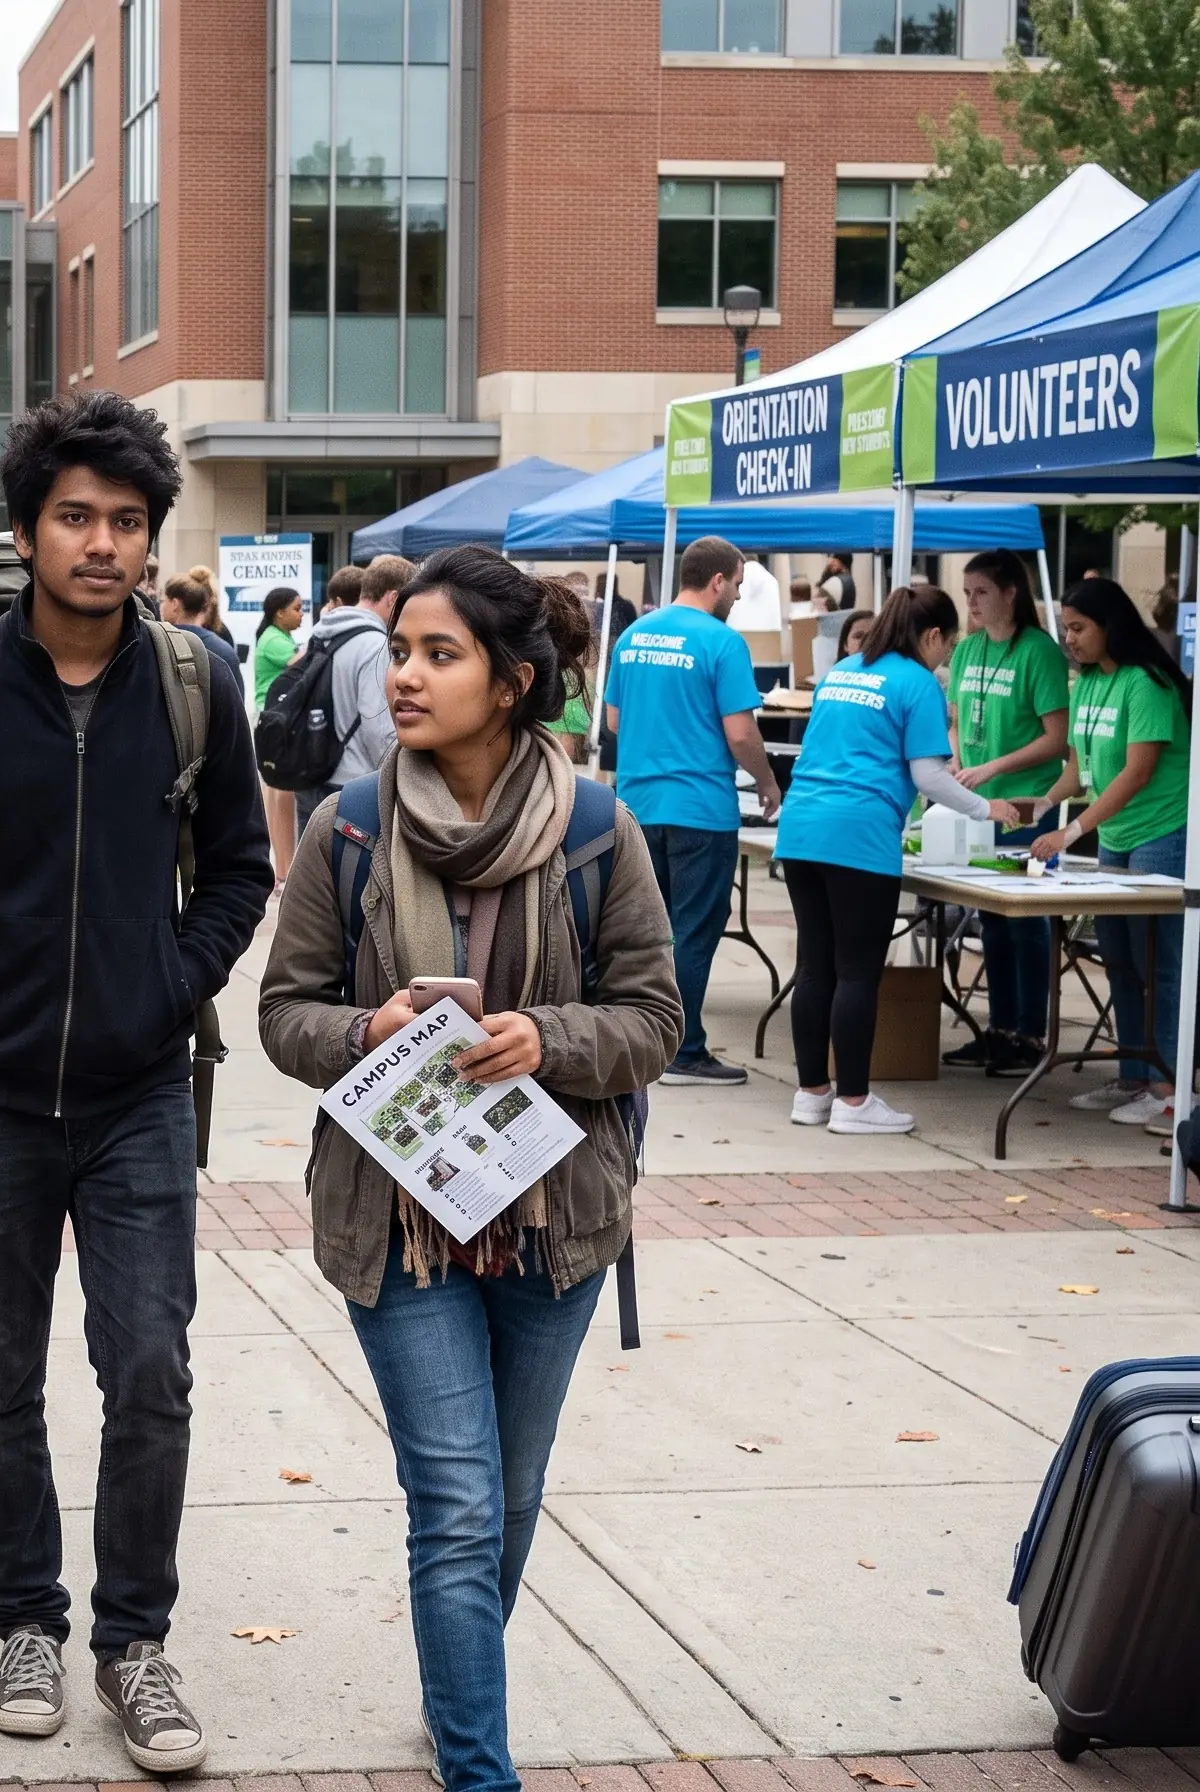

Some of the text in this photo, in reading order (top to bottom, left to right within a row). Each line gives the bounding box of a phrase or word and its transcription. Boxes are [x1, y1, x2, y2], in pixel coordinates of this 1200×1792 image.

[722, 384, 828, 446] ORIENTATION
[945, 348, 1141, 450] VOLUNTEERS
[736, 443, 812, 496] CHECK-IN
[341, 1013, 449, 1107] CAMPUS MAP
